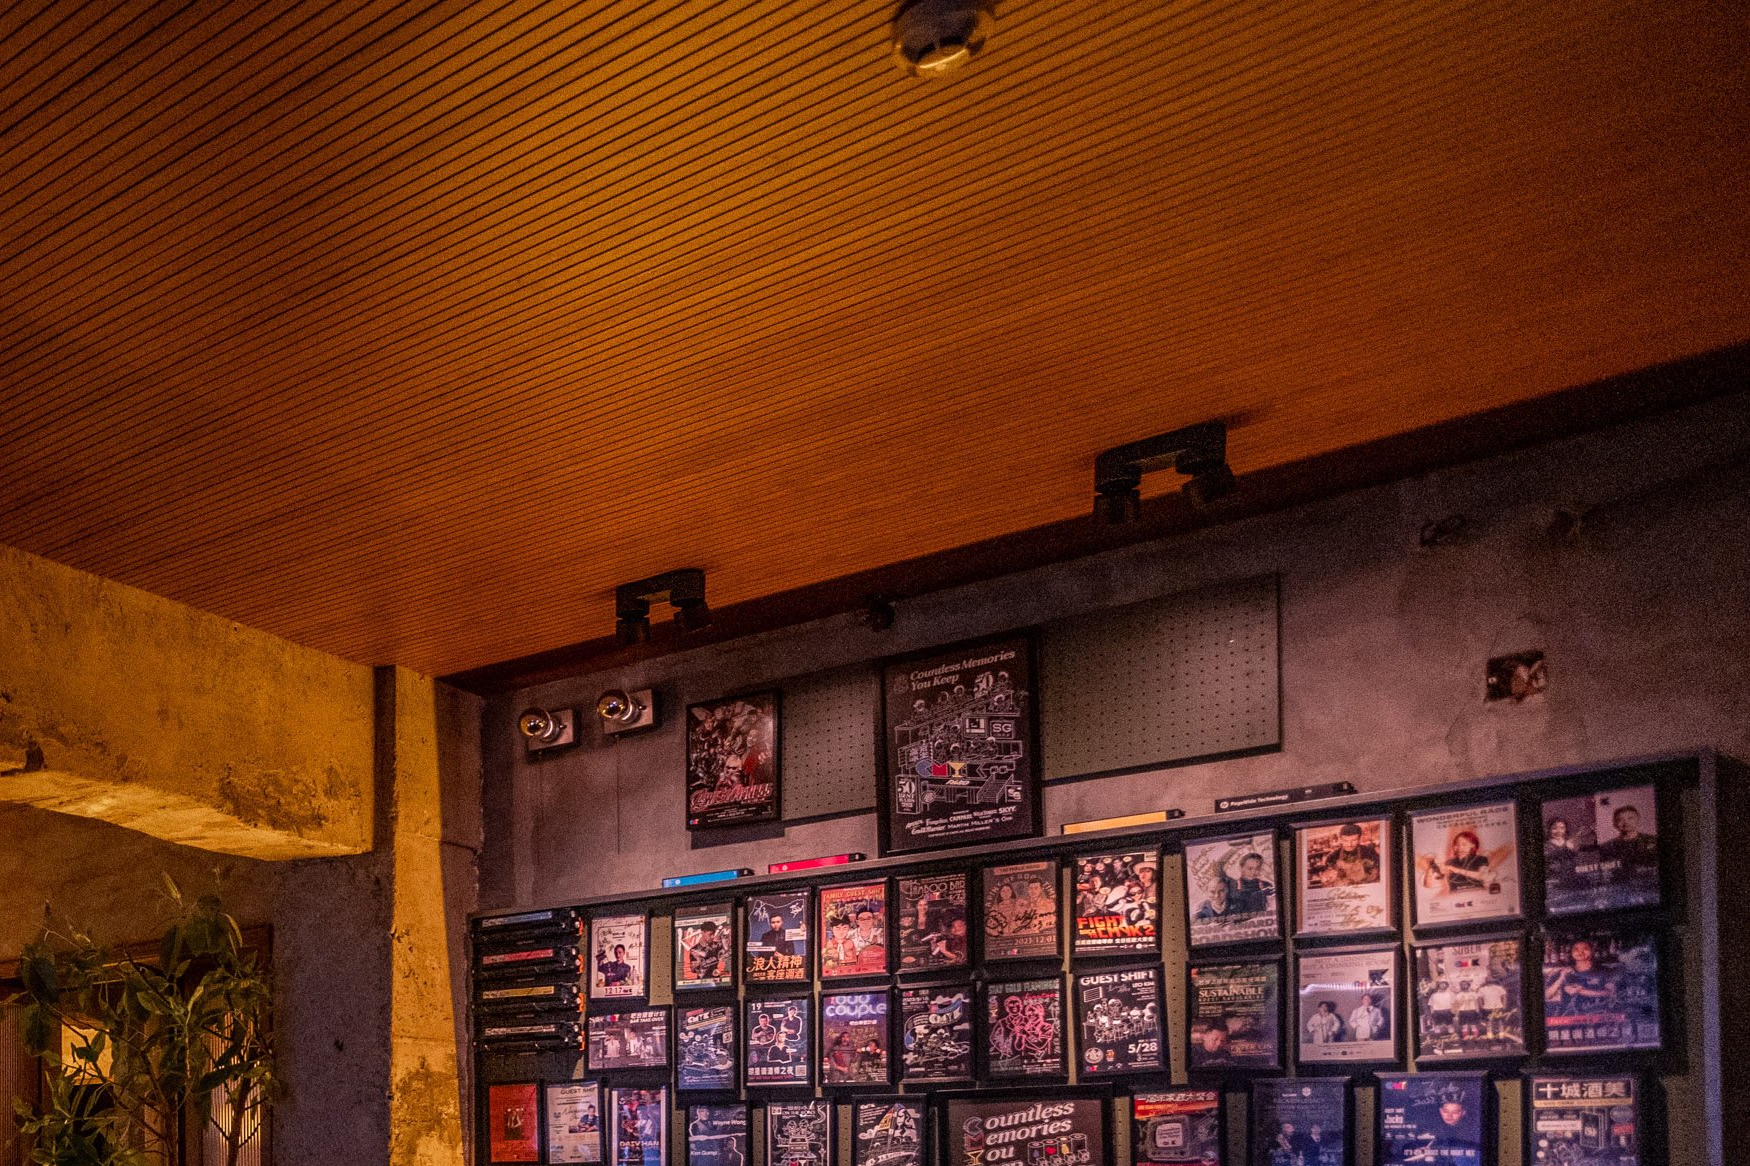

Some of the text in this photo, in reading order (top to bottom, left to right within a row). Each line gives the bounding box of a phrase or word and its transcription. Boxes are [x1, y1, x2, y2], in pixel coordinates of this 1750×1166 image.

[910, 662, 961, 681] Countless
[911, 674, 960, 691] You Keep
[1077, 915, 1126, 929] FIGHT
[1143, 924, 1156, 936] 2
[1081, 970, 1154, 986] GUEST SHIFT
[1198, 985, 1265, 998] SUSTAINABLE
[751, 1003, 762, 1011] 19
[1128, 1041, 1158, 1054] 5/28
